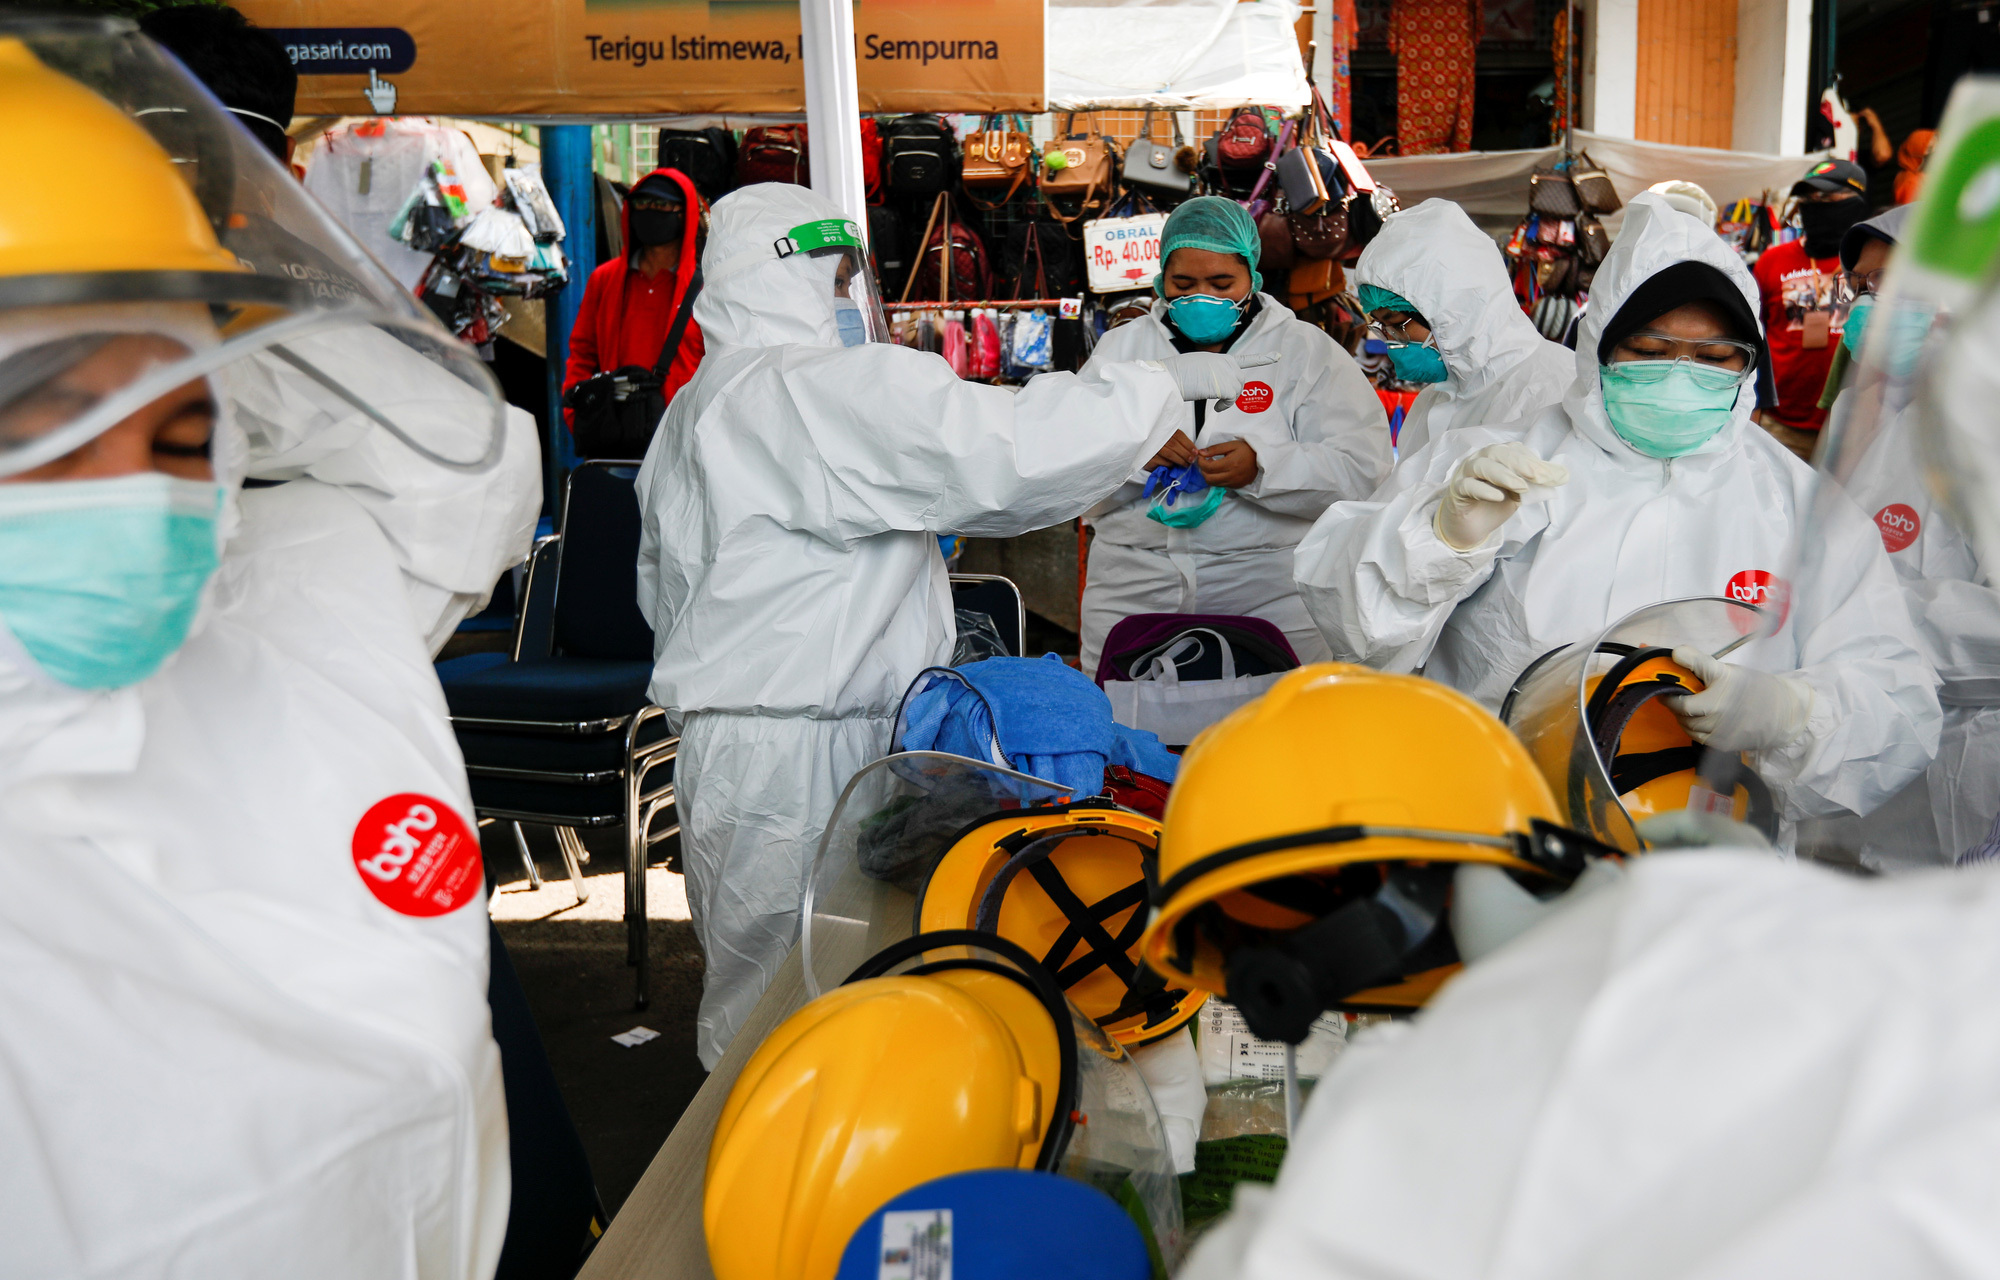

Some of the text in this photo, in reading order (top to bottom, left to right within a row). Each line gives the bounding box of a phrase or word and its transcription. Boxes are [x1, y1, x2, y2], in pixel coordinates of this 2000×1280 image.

[285, 39, 392, 65] gasari.com
[585, 35, 664, 67] Terigu
[671, 35, 791, 64] Istimewa,
[864, 34, 999, 66] Sempurna
[1105, 226, 1157, 241] OBRAL
[1094, 245, 1118, 271] Rp.
[1881, 508, 1915, 532] boho
[360, 803, 438, 882] boho
